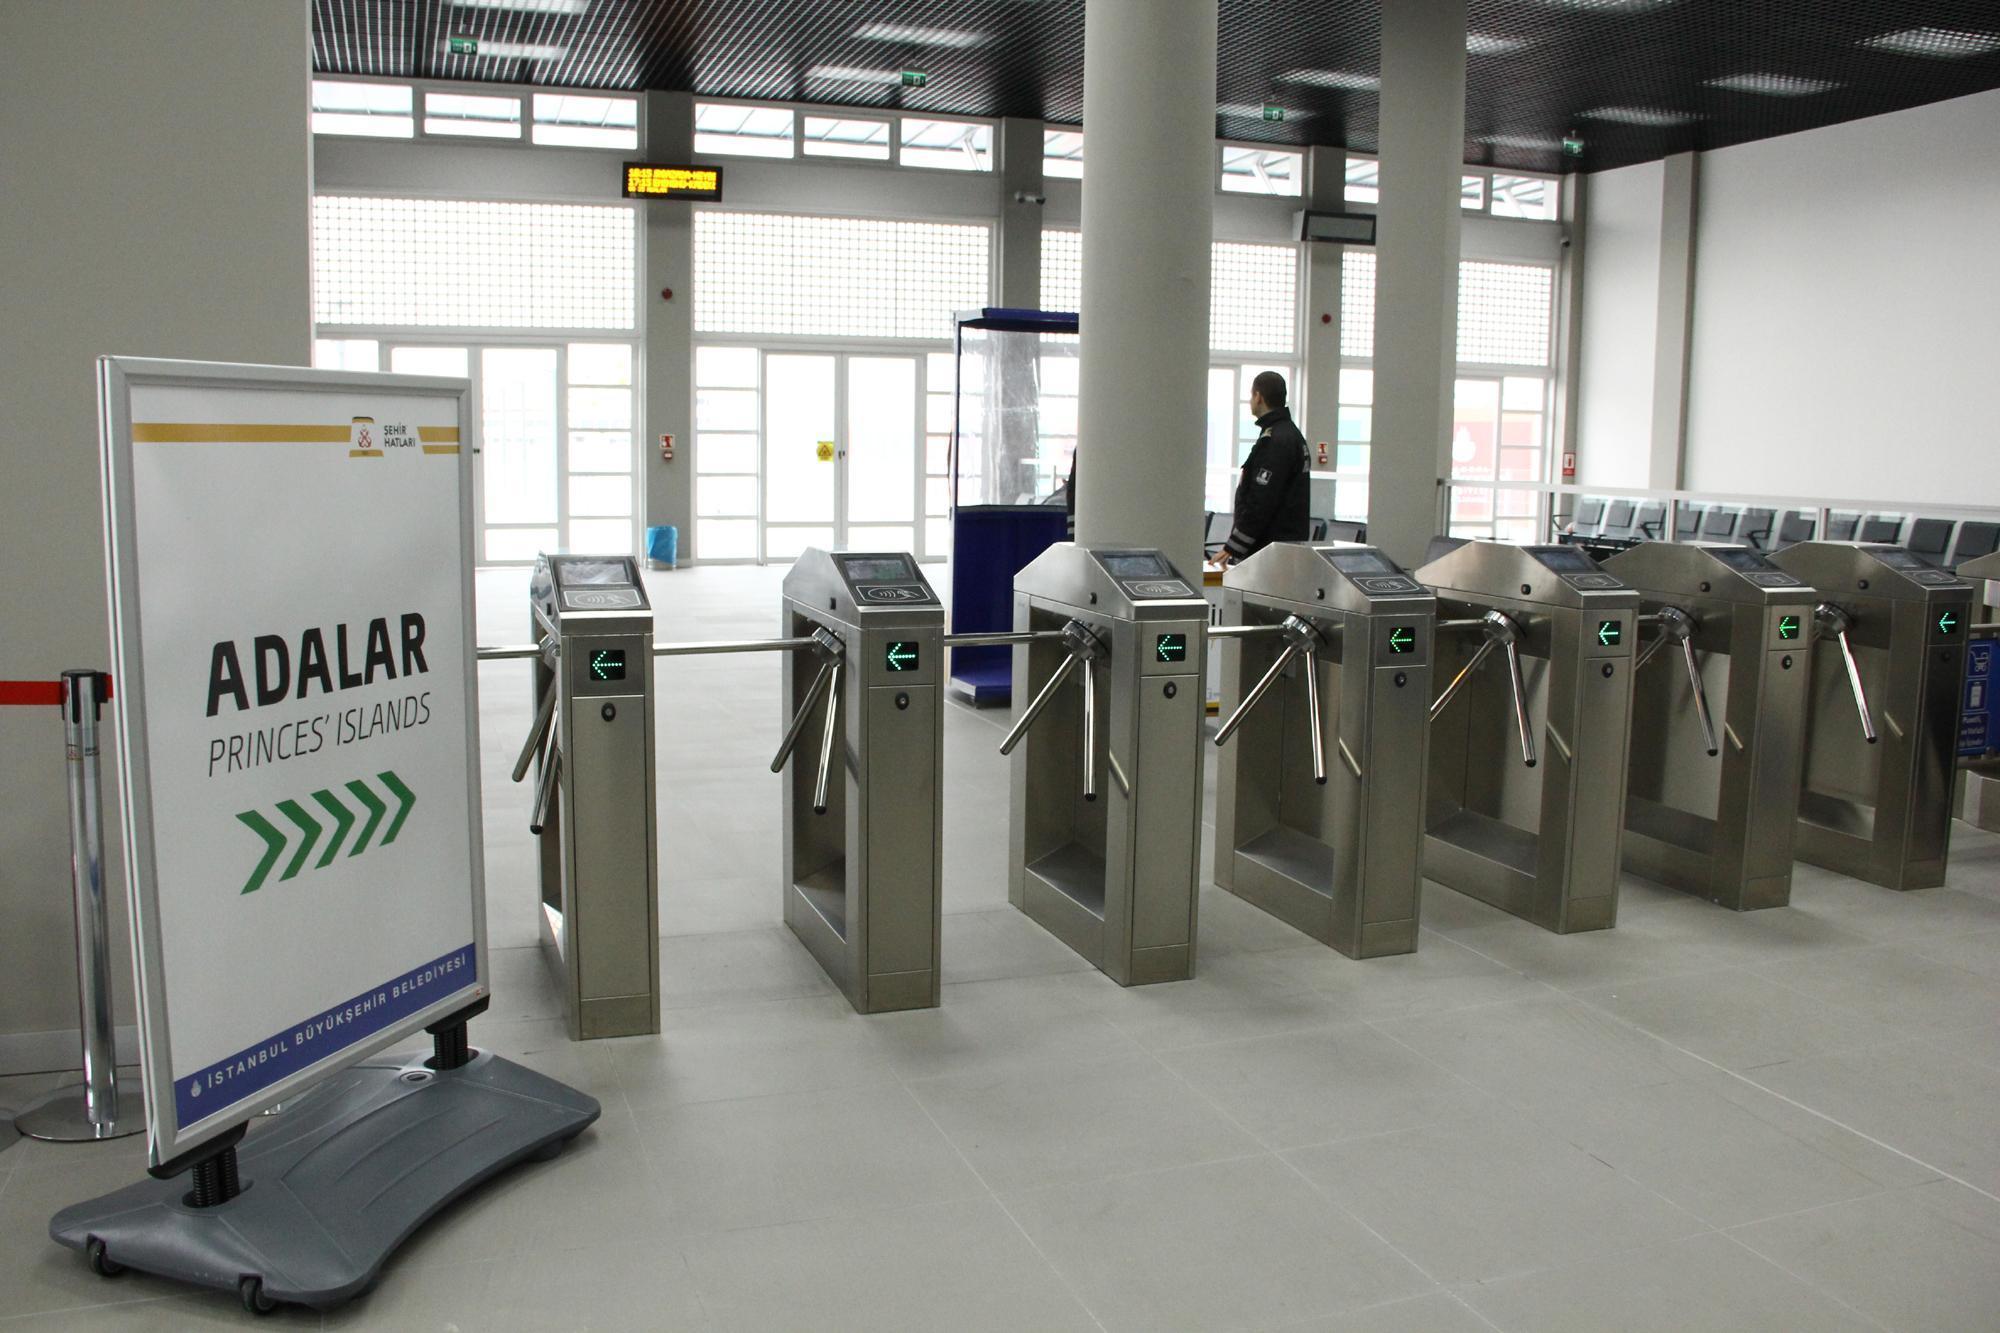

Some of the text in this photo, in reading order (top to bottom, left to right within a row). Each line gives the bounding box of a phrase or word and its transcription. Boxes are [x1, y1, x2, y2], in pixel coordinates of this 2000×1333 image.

[384, 437, 416, 448] HATLARI
[206, 612, 429, 717] ADALAR
[208, 692, 431, 778] PRINCES' ISLANDS
[208, 952, 467, 1089] İSTANBUL BÜYÜKŞEHİR BELEDİYESİ
